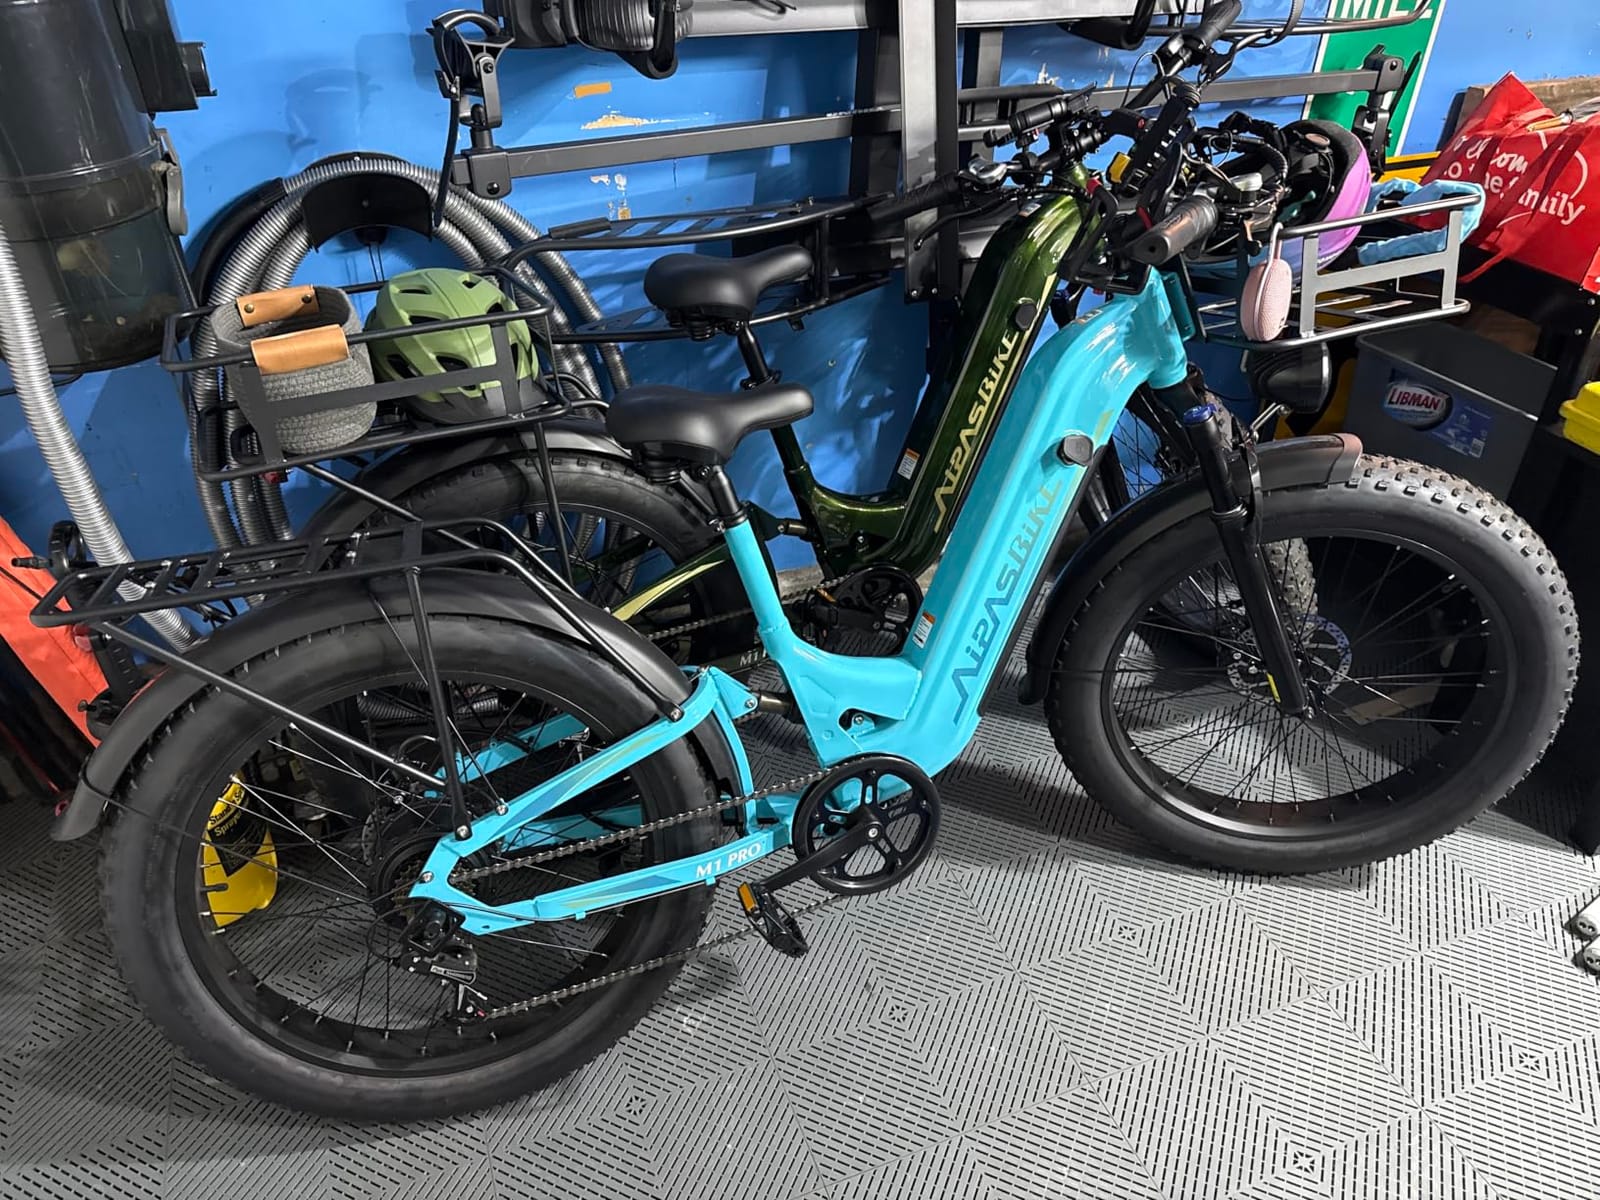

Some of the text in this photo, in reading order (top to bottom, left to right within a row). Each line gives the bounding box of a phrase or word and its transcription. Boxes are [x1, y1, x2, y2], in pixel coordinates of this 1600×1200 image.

[1388, 388, 1441, 411] LIBMAN
[695, 842, 761, 879] M1 PRO
